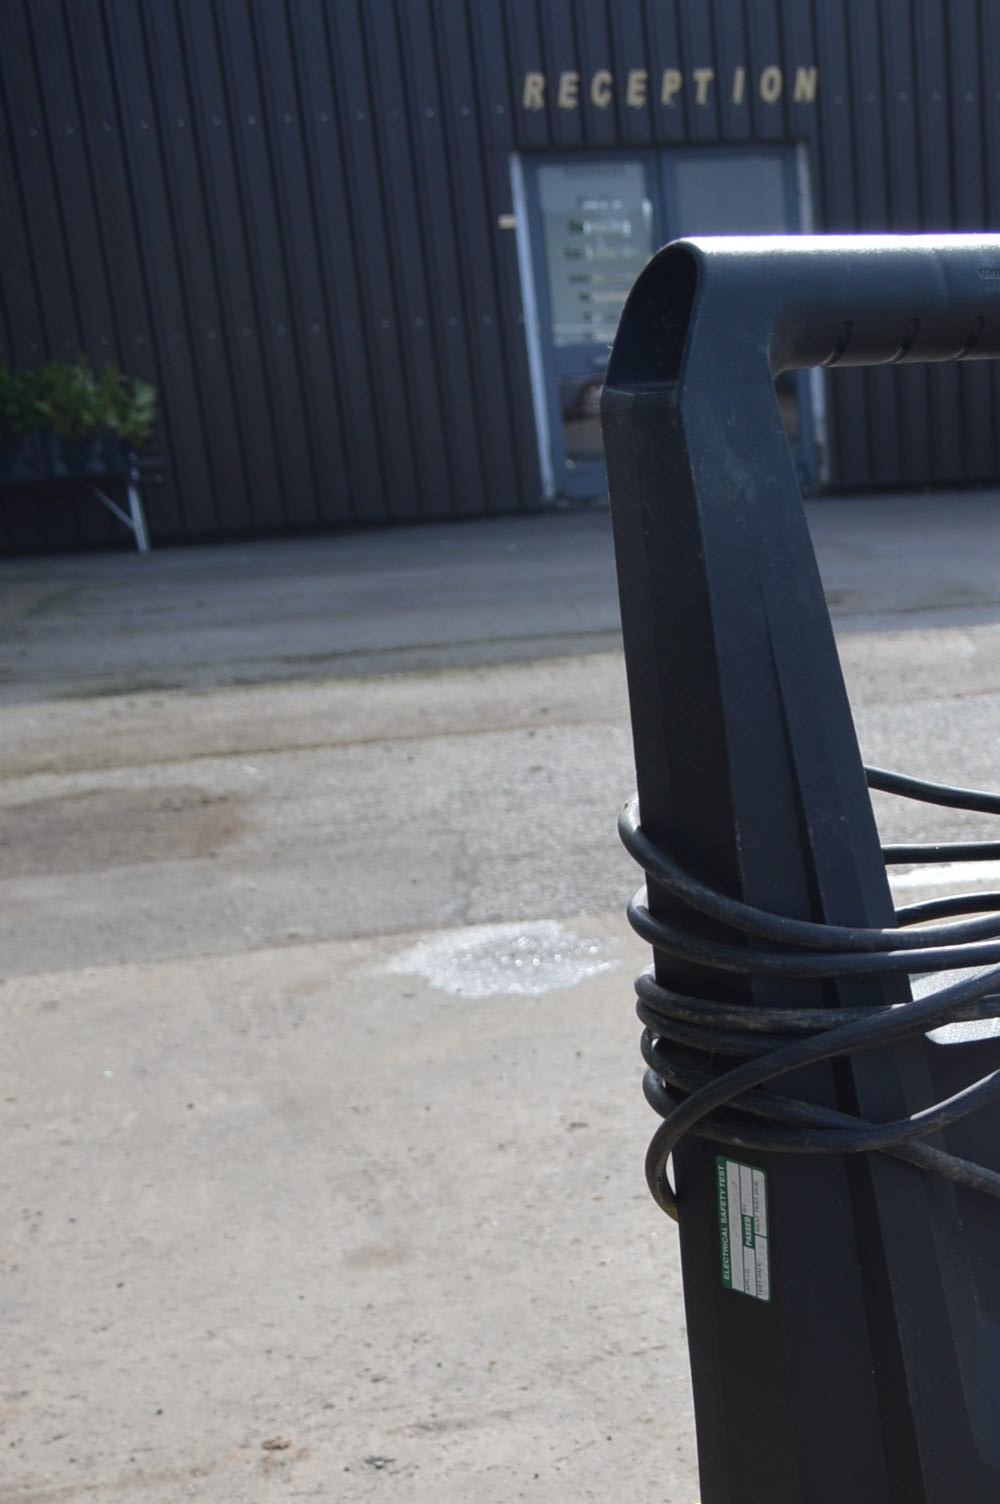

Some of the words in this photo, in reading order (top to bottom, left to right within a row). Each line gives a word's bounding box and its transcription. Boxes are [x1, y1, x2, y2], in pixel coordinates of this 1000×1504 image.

[522, 65, 818, 109] RECEPTION
[718, 1164, 726, 1187] TEST
[719, 1190, 728, 1223] SAFETY
[744, 1215, 753, 1247] PASSED
[720, 1226, 731, 1280] ELECTRICAL
